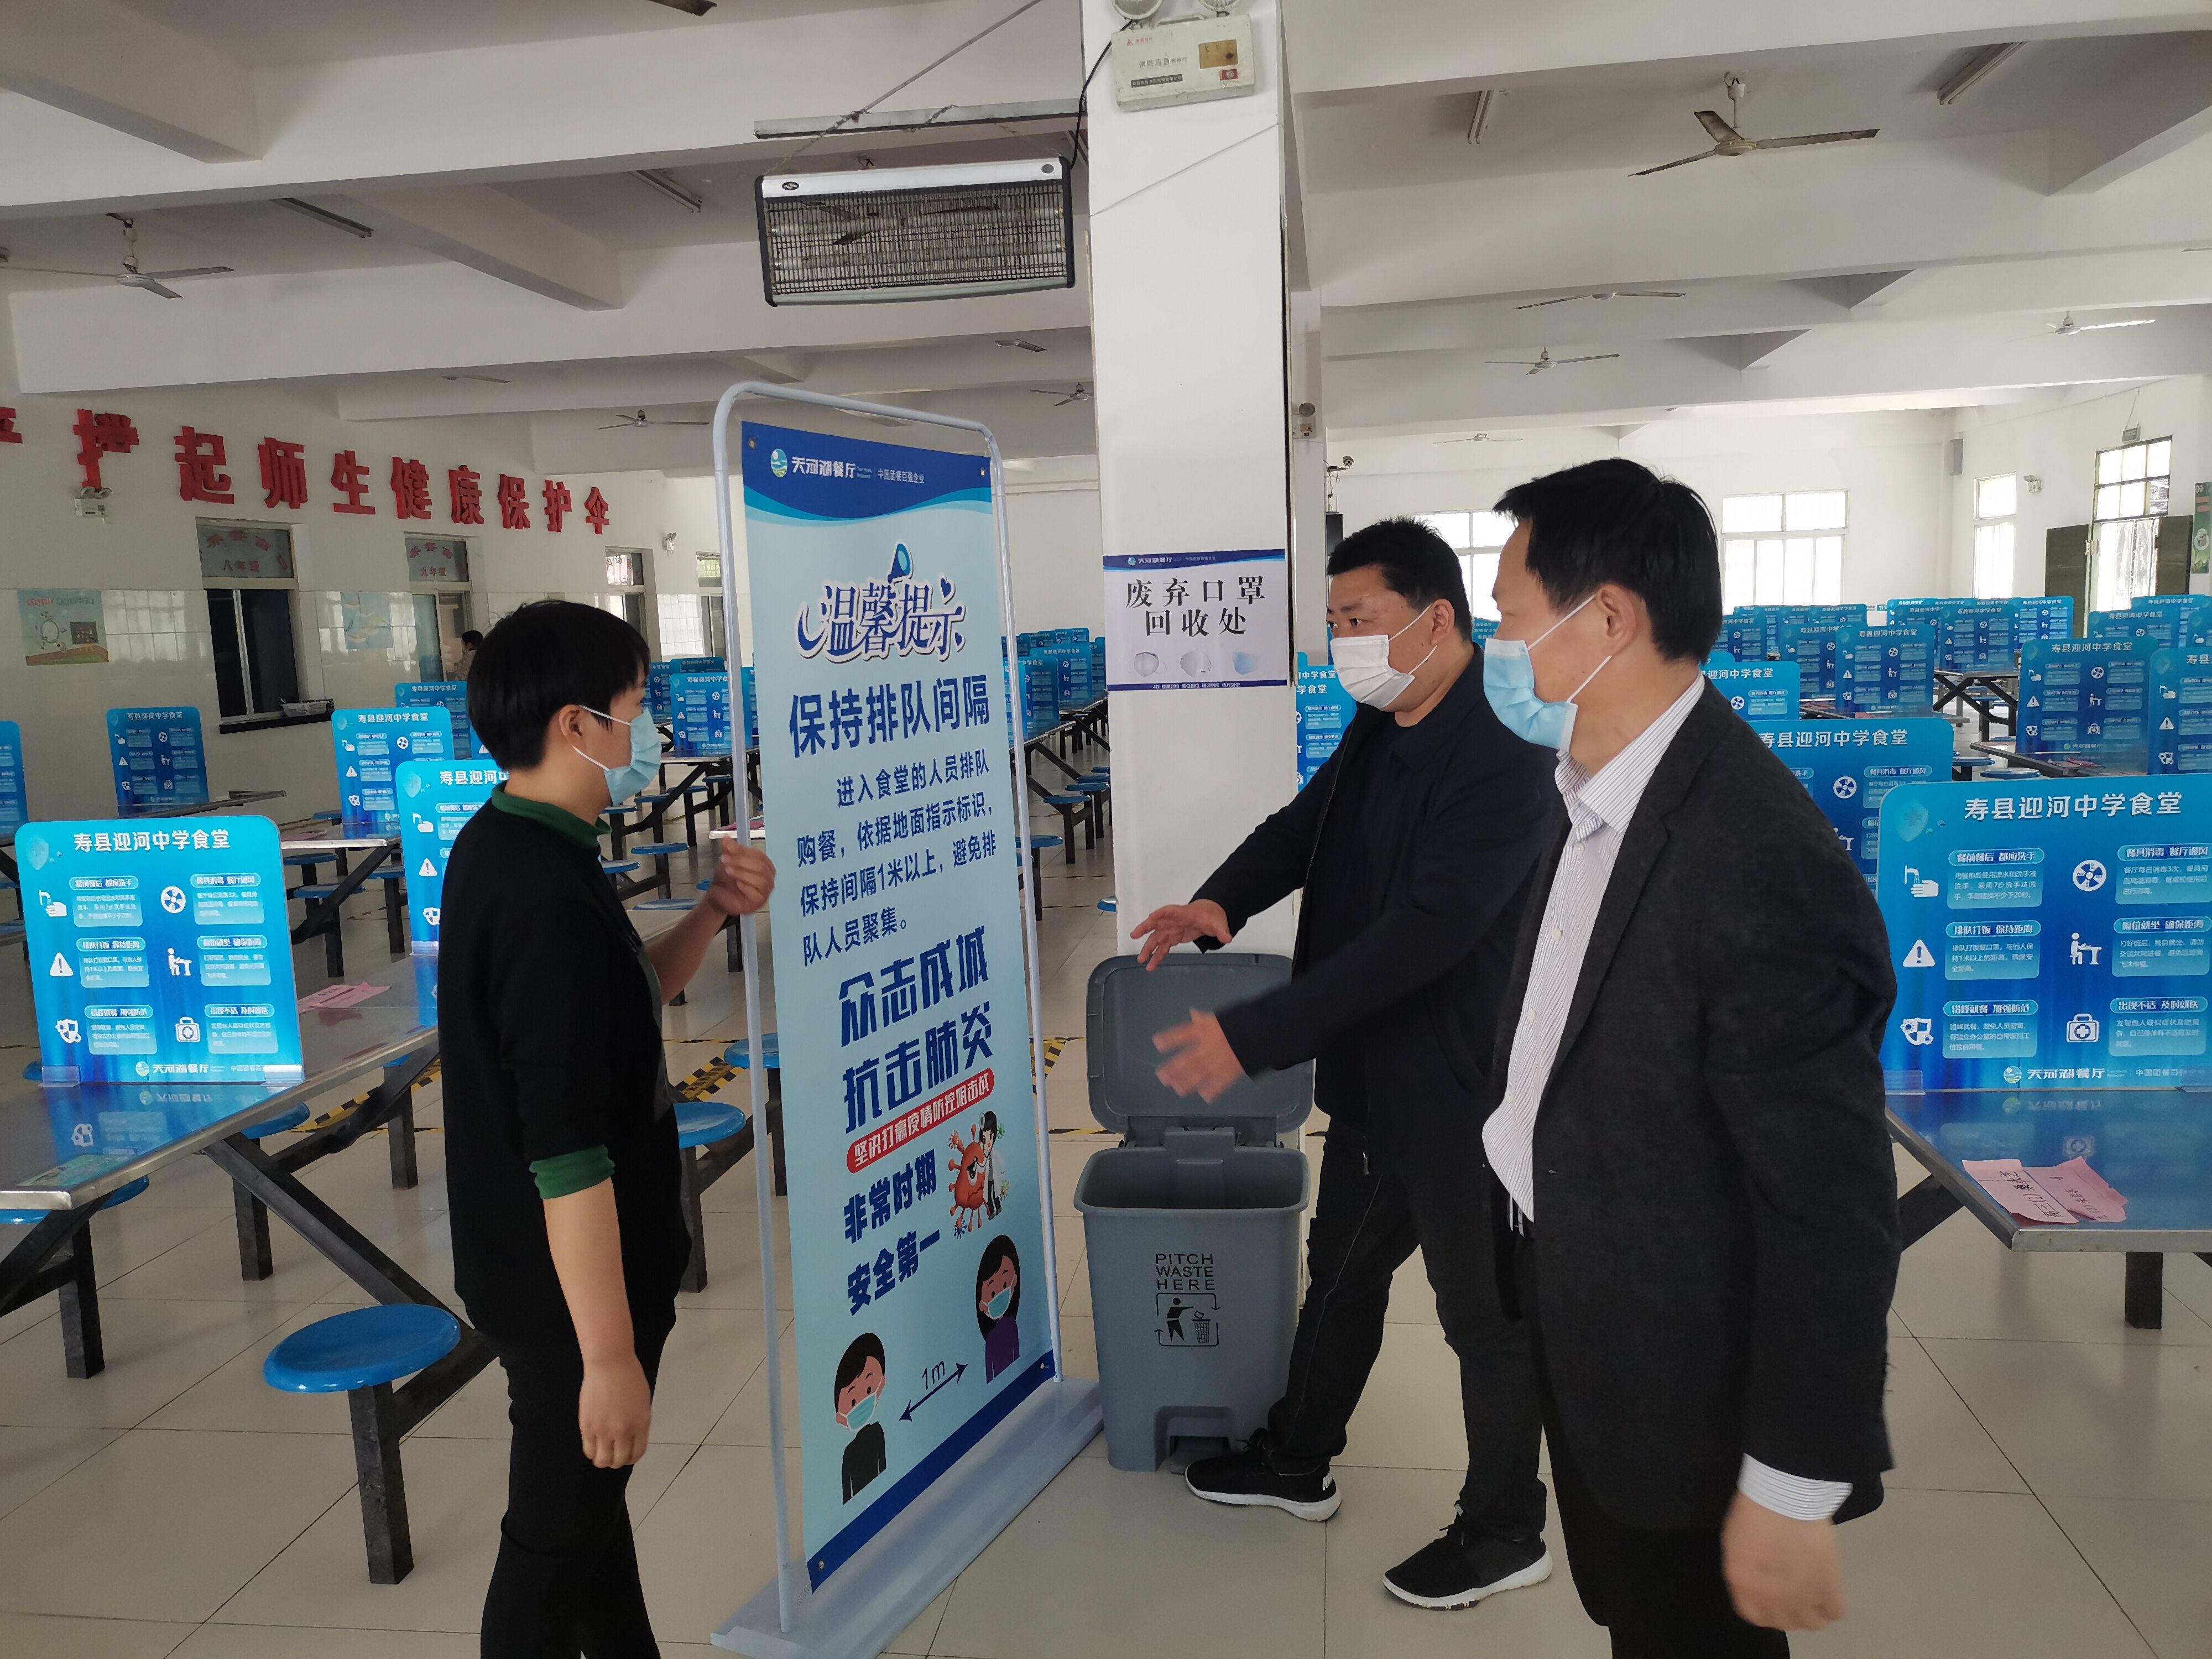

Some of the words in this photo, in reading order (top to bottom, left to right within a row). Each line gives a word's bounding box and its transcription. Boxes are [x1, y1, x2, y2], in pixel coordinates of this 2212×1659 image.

[791, 457, 855, 479] 天河湖餐厅
[1126, 576, 1265, 608] 废弃口罩
[797, 582, 964, 658] 温馨提示
[1146, 607, 1247, 637] 回收处
[1859, 629, 1917, 638] 寿县迎河中学食堂
[2051, 641, 2132, 653] 寿县迎河中学食堂
[358, 712, 429, 723] 寿县迎河中学食堂
[789, 675, 989, 758] 保持排队间隔
[1759, 729, 1908, 749] 寿县迎河中学食堂
[837, 749, 989, 808] 进入食堂的人员排队
[1964, 791, 2183, 821] 寿县迎河中学食堂
[74, 829, 231, 852] 寿县迎河中学食堂
[797, 792, 993, 868] 购餐，依据地面指示标识，
[1957, 852, 1994, 863] 餐前餐后
[1999, 851, 2037, 861] 都应洗手
[2126, 847, 2164, 857] 餐具消毒
[2169, 846, 2208, 855] 餐厅通风
[800, 830, 996, 917] 保持间隔1米以上，避免排
[1954, 925, 1991, 935] 排队打饭
[1996, 925, 2033, 934] 保持距离
[2165, 920, 2204, 929] 确保距离
[804, 906, 906, 967] 队人员聚集。
[839, 925, 988, 1047] 众志成城
[1952, 1005, 1988, 1014] 错峰就餐
[1992, 1004, 2030, 1014] 加强防范
[2118, 1001, 2156, 1010] 出现不适
[2161, 1000, 2199, 1009] 及时就医
[153, 1063, 208, 1074] 天河湖餐厅
[843, 1001, 993, 1134] 抗击肺炎
[2027, 1068, 2105, 1079] 天河湖餐厅
[854, 1073, 990, 1167] 坚决打赢疫情防控阻击战
[843, 1149, 936, 1245] 非常时期
[1155, 1253, 1213, 1265] PITCH
[848, 1229, 940, 1316] 安全第一
[1156, 1266, 1214, 1277] WASTE
[1157, 1279, 1215, 1290] HERE
[921, 1360, 946, 1390] 1m
